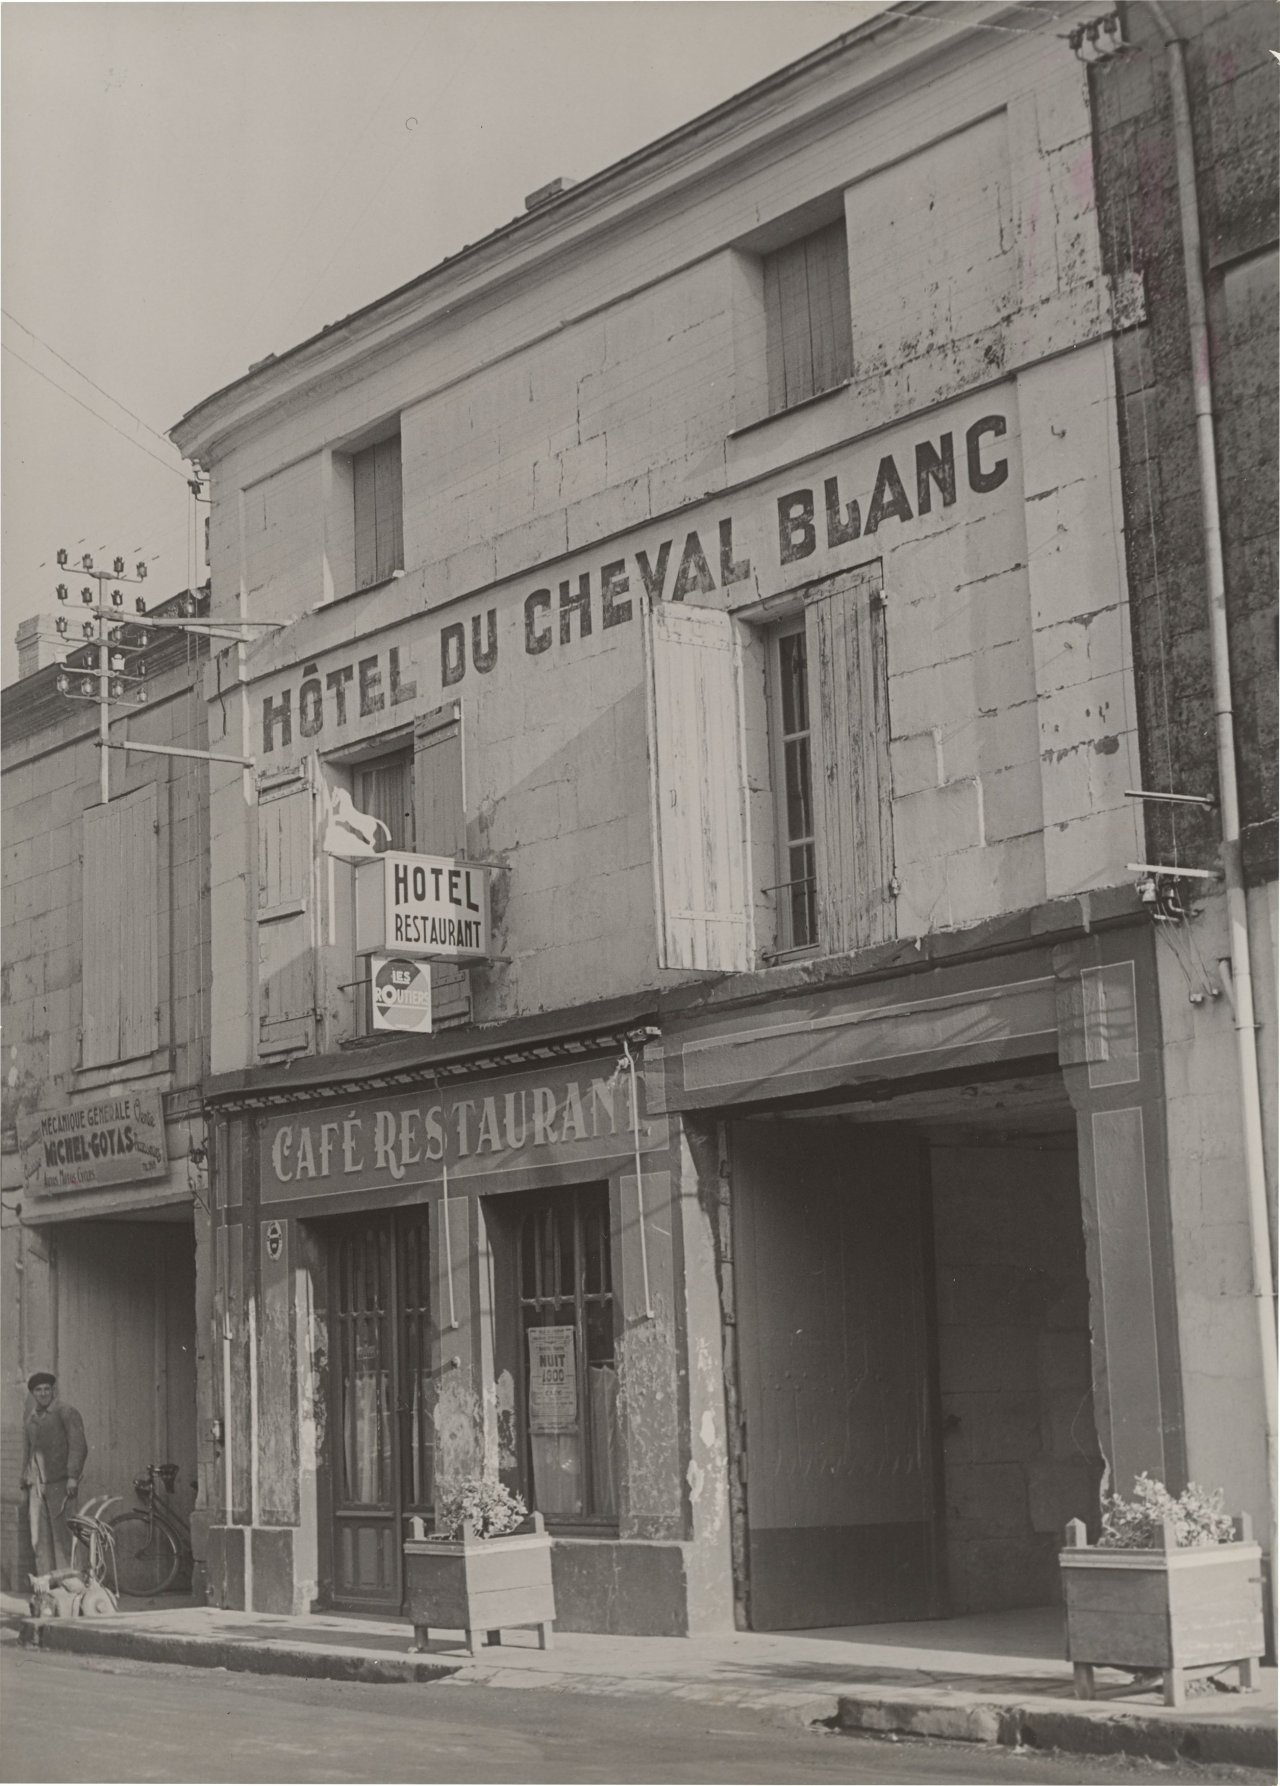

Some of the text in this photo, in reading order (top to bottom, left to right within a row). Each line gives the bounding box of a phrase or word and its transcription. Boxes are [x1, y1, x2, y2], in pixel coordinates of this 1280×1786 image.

[263, 414, 1009, 753] HÔTEL DU CHEVAL BLANC
[394, 863, 480, 912] HOTEL
[394, 913, 481, 948] RESTAURANT
[392, 969, 411, 985] LES
[375, 984, 429, 1006] ROUTIERS
[271, 1071, 645, 1183] CAFÉ RESTAURANT
[539, 1353, 565, 1368] NUIT
